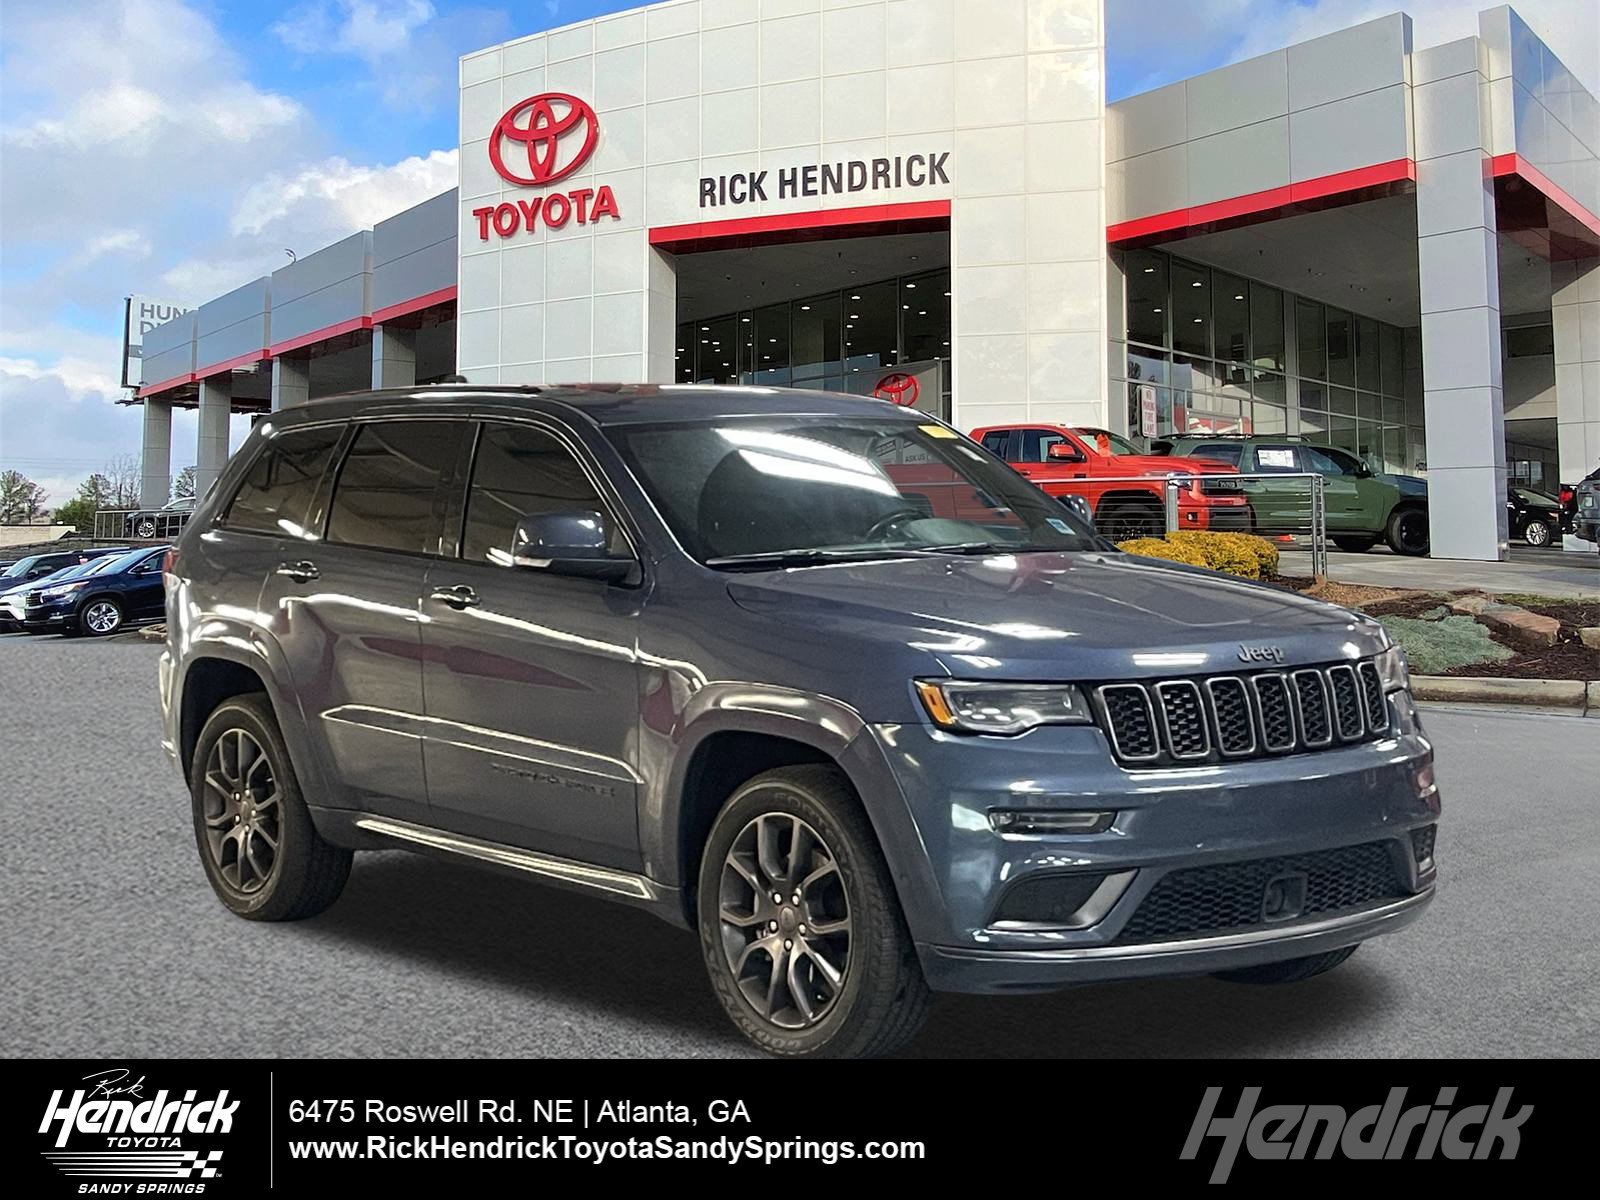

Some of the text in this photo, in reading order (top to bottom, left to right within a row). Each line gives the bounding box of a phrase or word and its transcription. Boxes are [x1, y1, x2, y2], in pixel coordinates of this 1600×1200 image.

[699, 152, 950, 208] RICK HENDRICK
[473, 185, 620, 241] TOYOTA
[1238, 642, 1284, 664] Jeep
